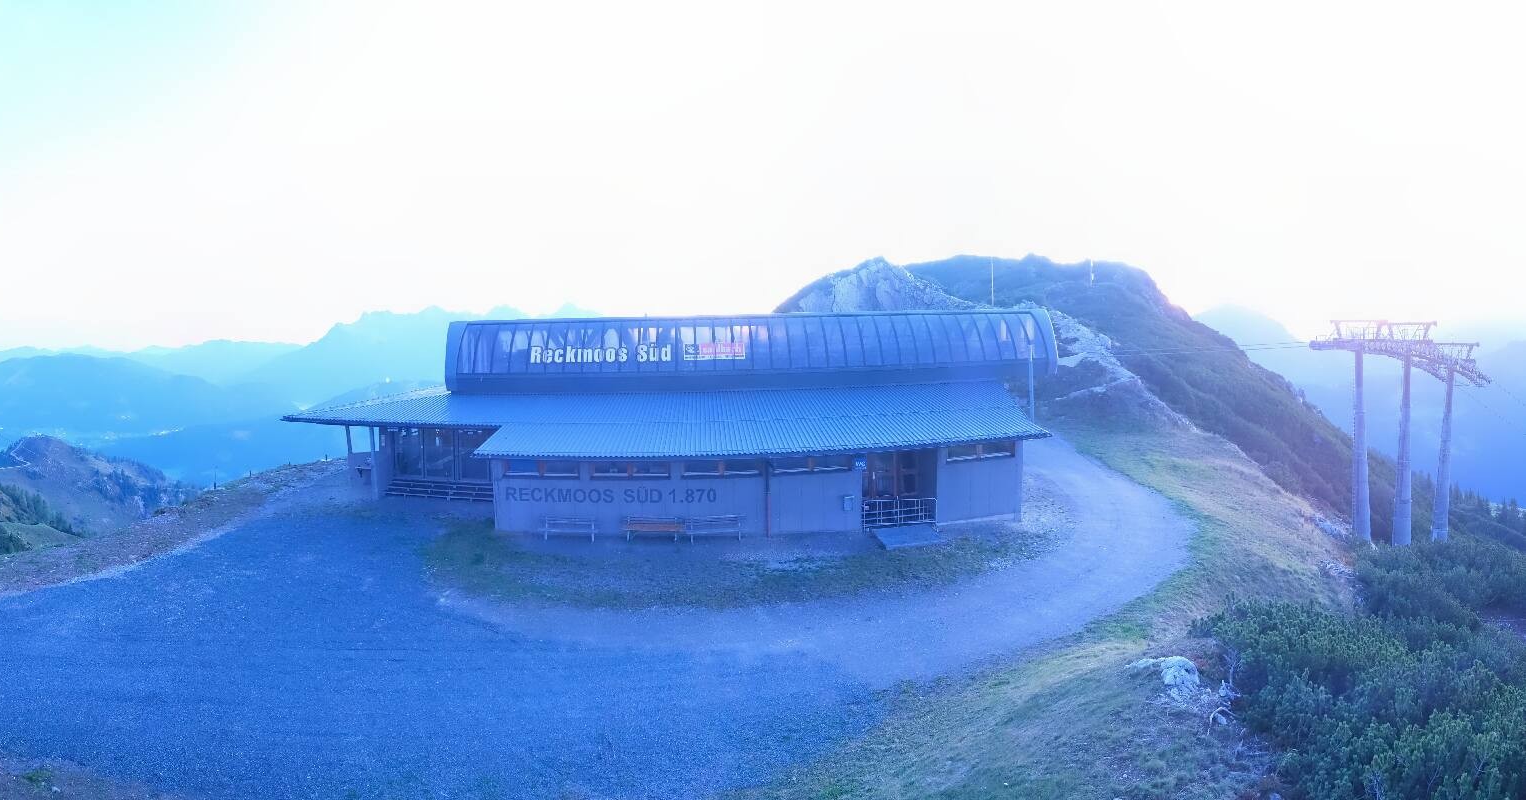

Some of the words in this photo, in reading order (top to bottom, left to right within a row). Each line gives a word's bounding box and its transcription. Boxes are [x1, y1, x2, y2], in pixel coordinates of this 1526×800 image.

[530, 345, 628, 363] Reckmoos
[637, 343, 672, 362] Süd
[505, 486, 615, 504] RECKMOOS
[623, 486, 663, 504] SÜD
[669, 488, 717, 504] 1.870
